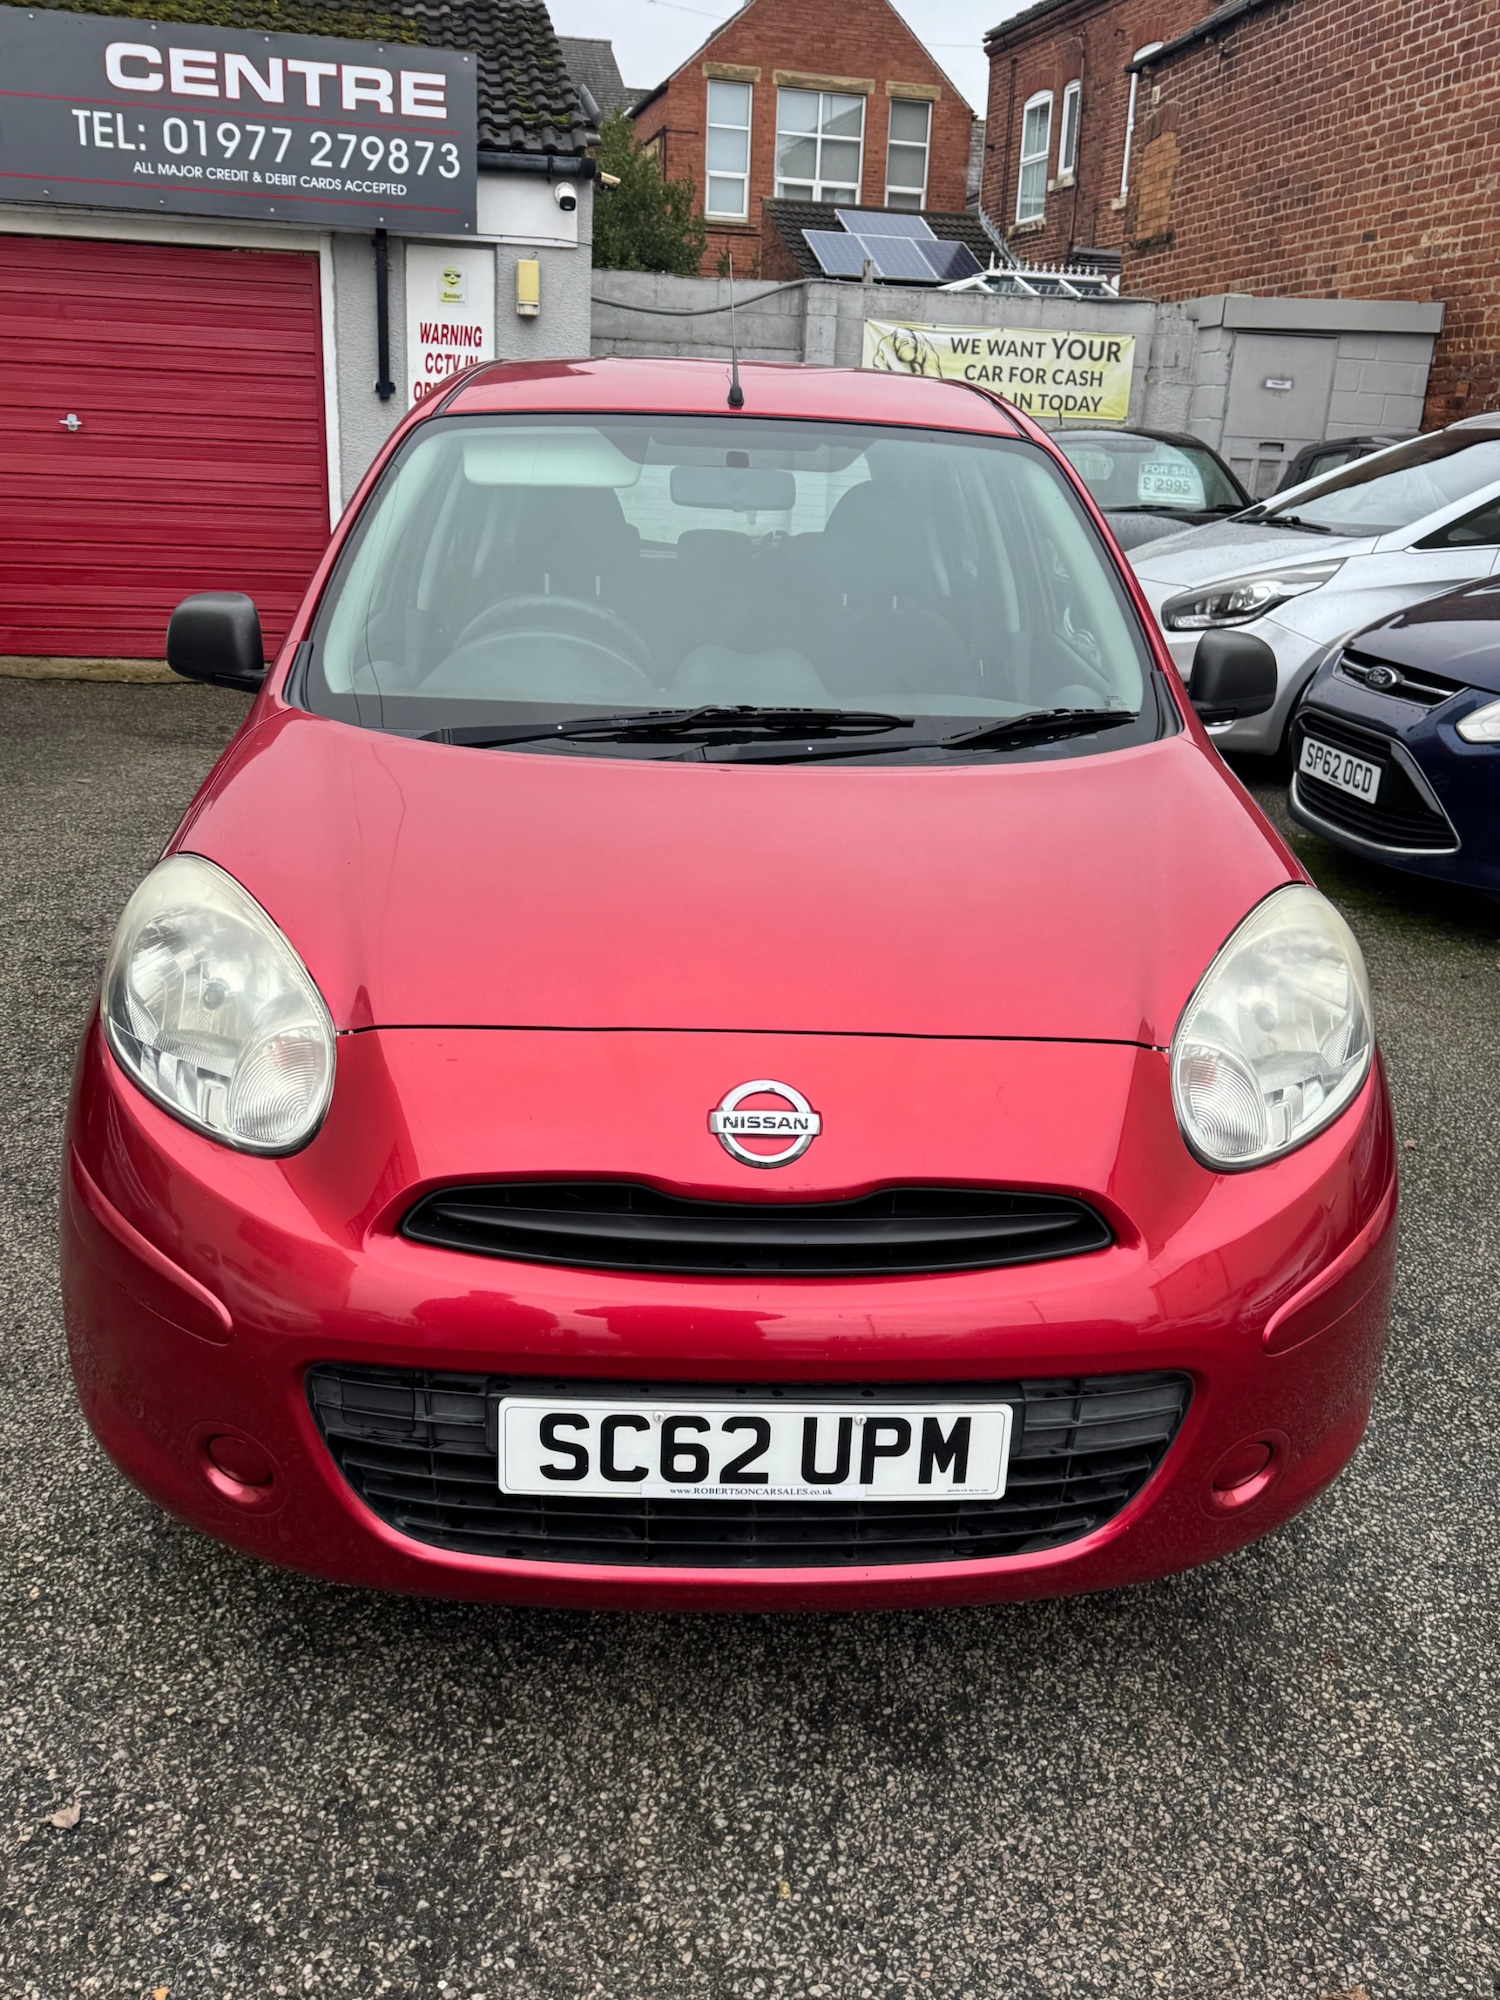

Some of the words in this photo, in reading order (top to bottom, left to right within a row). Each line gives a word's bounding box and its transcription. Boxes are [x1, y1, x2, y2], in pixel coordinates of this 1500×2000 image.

[105, 41, 448, 120] CENTRE
[71, 108, 147, 151] TEL:
[162, 117, 293, 163] 01977
[309, 130, 461, 179] 279873
[133, 161, 155, 175] ALL
[157, 163, 203, 179] MAJOR
[206, 166, 250, 182] CREDIT
[252, 171, 263, 184] &
[265, 172, 298, 187] DEBIT
[300, 175, 342, 191] CARDS
[344, 180, 407, 196] ACCEPTED
[419, 322, 483, 348] WARNING
[950, 336, 981, 355] WE
[986, 339, 1047, 359] WANT
[1051, 338, 1122, 363] YOUR
[424, 352, 461, 375] CCTV
[964, 364, 1004, 382] CAR
[1008, 366, 1048, 385] FOR
[1052, 369, 1104, 388] CASH
[1013, 392, 1033, 409] IN
[1037, 394, 1103, 413] TODAY
[1144, 464, 1169, 474] FOR
[1142, 476, 1152, 490] £
[1155, 478, 1191, 493] 2995
[1305, 742, 1342, 780] SP62
[722, 1116, 809, 1130] NISSAN
[539, 1412, 772, 1485] SC62
[800, 1416, 972, 1485] UPM
[669, 1487, 833, 1496] www.ROBERTSONCARSALES.co.uk
